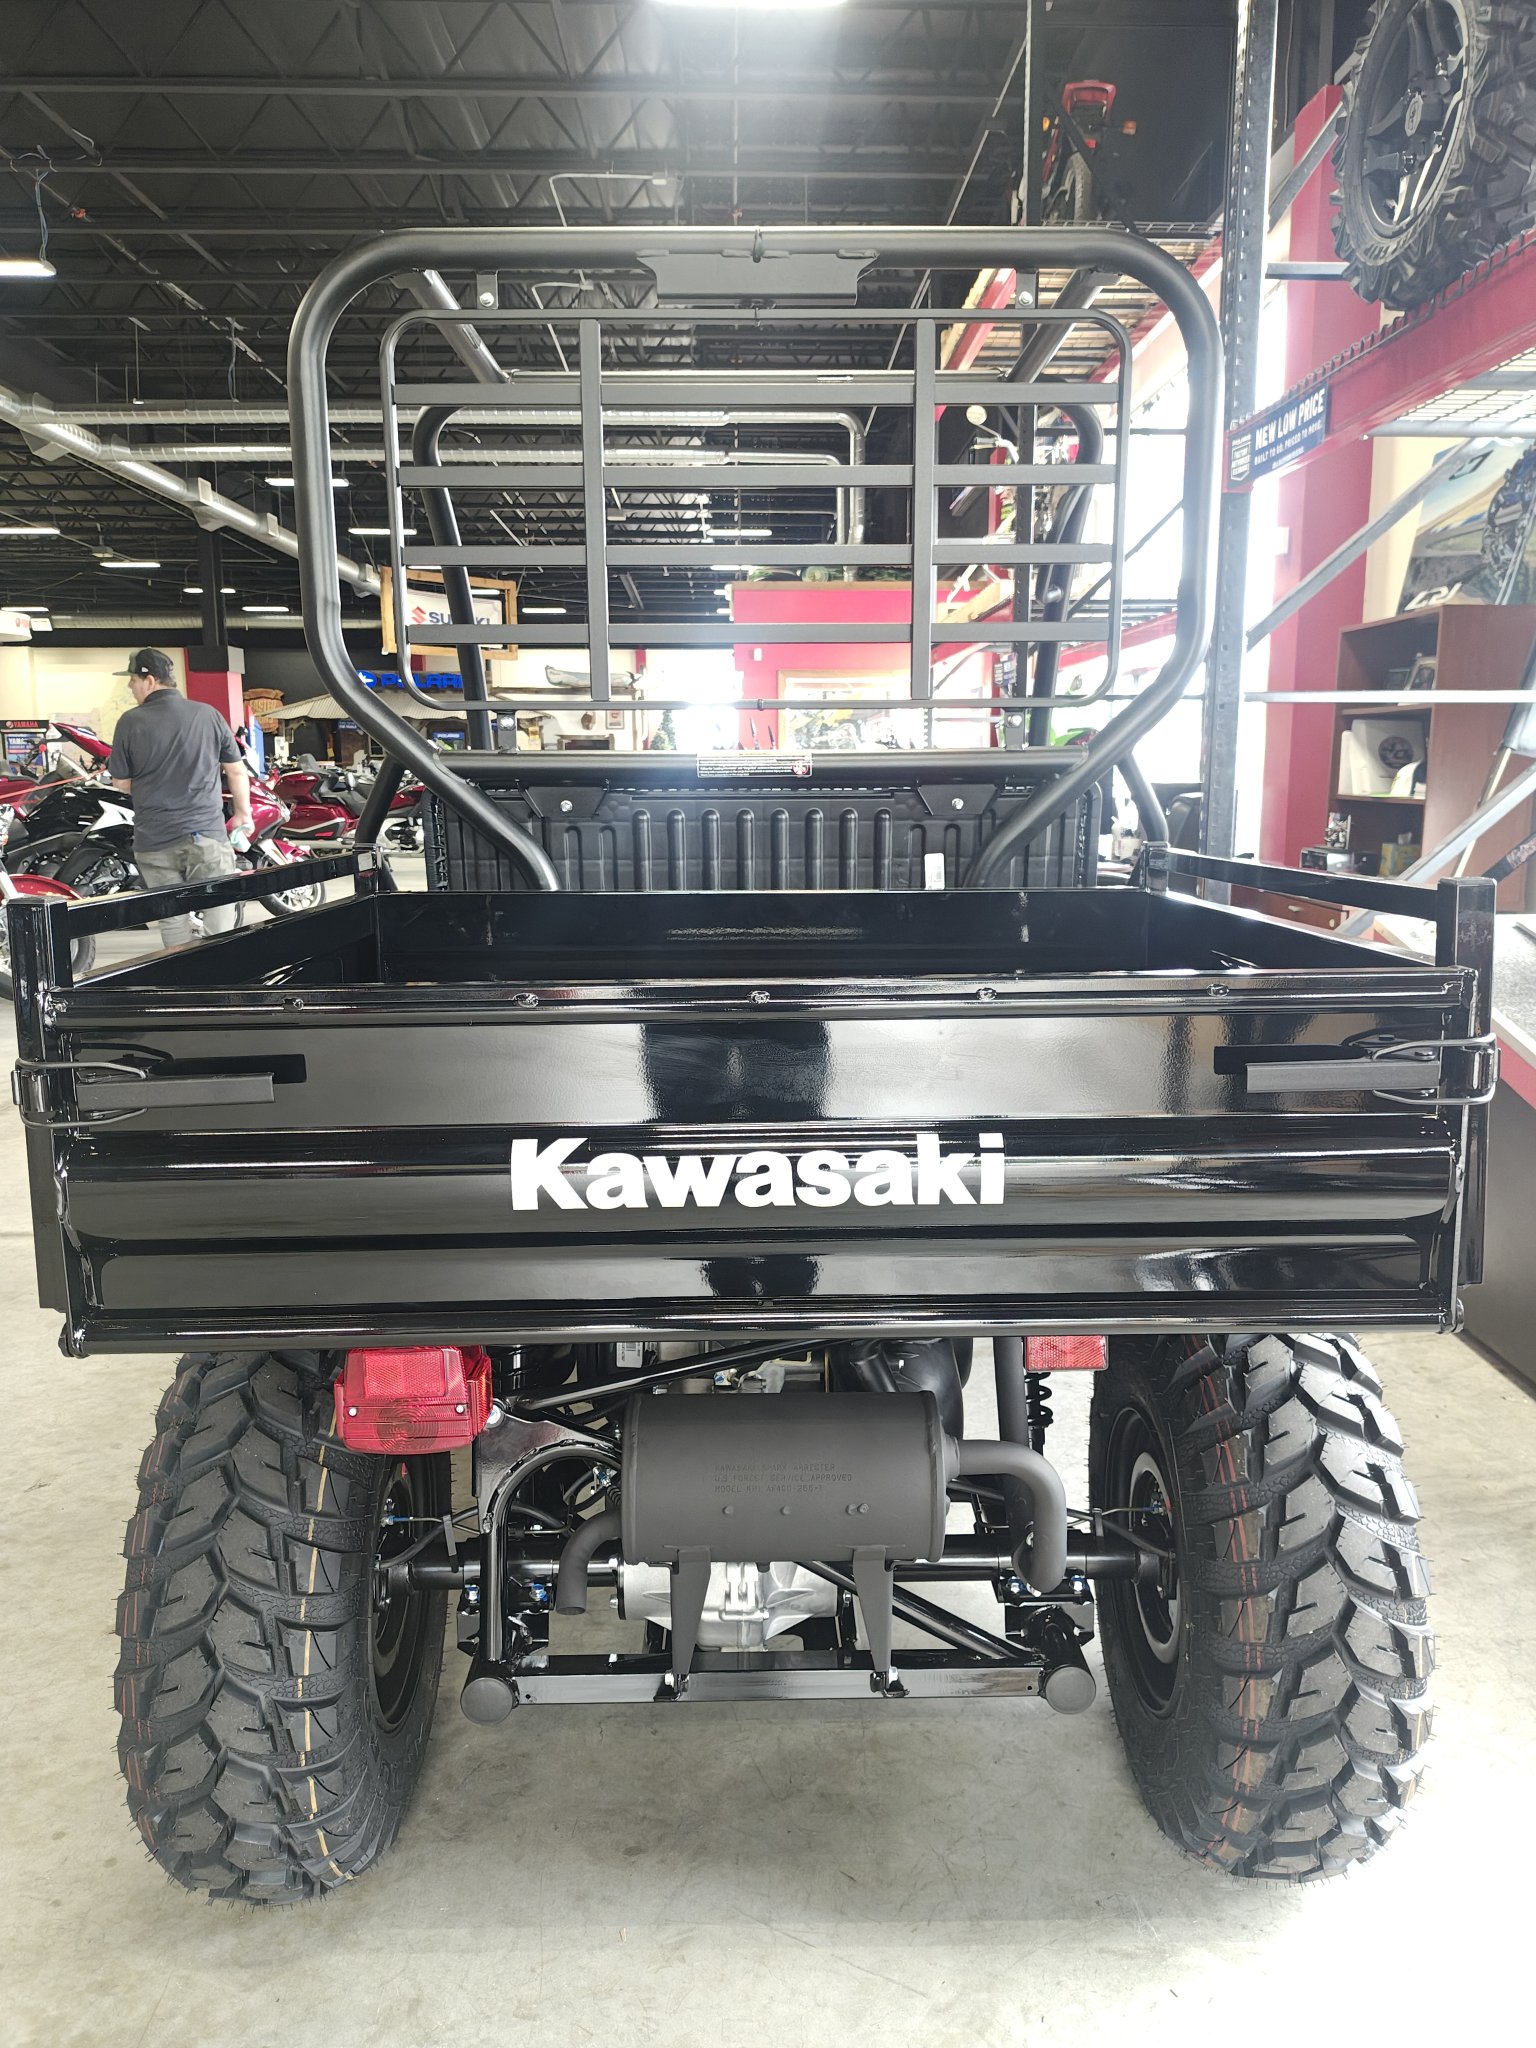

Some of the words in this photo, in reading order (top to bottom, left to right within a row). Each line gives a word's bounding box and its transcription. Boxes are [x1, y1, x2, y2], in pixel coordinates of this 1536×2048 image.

[1255, 420, 1277, 451] NEW
[1277, 407, 1298, 438] LOW
[1298, 388, 1326, 426] PRICE
[428, 612, 491, 625] SUKI
[511, 1132, 1005, 1210] Kawasaki
[793, 1463, 836, 1472] ARRESTER
[769, 1473, 804, 1482] SERVICE
[810, 1473, 853, 1482] APPROVED
[714, 1484, 742, 1493] MODEL
